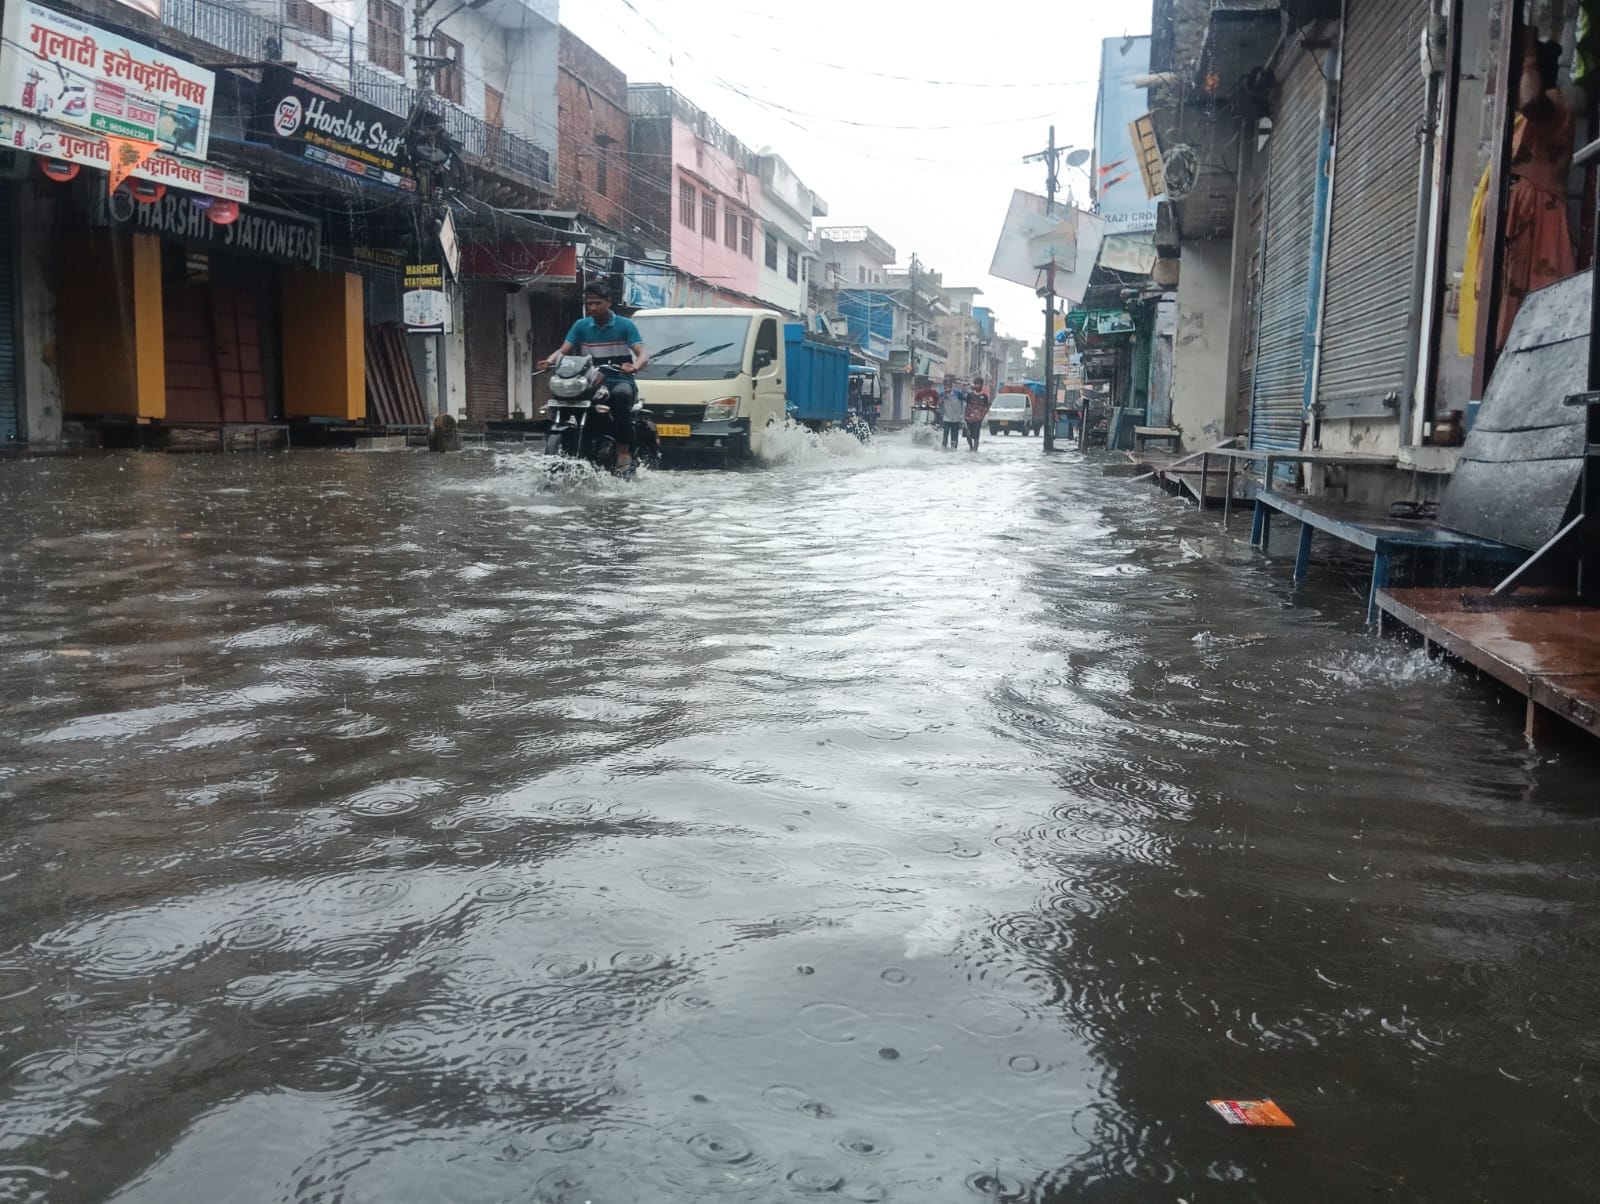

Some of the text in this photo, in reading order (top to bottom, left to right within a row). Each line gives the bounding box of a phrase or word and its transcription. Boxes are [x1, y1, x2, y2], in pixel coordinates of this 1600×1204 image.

[31, 23, 98, 67] गुलाटी
[305, 97, 365, 144] Harshit
[58, 134, 110, 161] गुलाटी
[224, 213, 313, 260] STATIONERS
[404, 277, 441, 288] STATIONERS
[406, 264, 438, 275] HARSHIT
